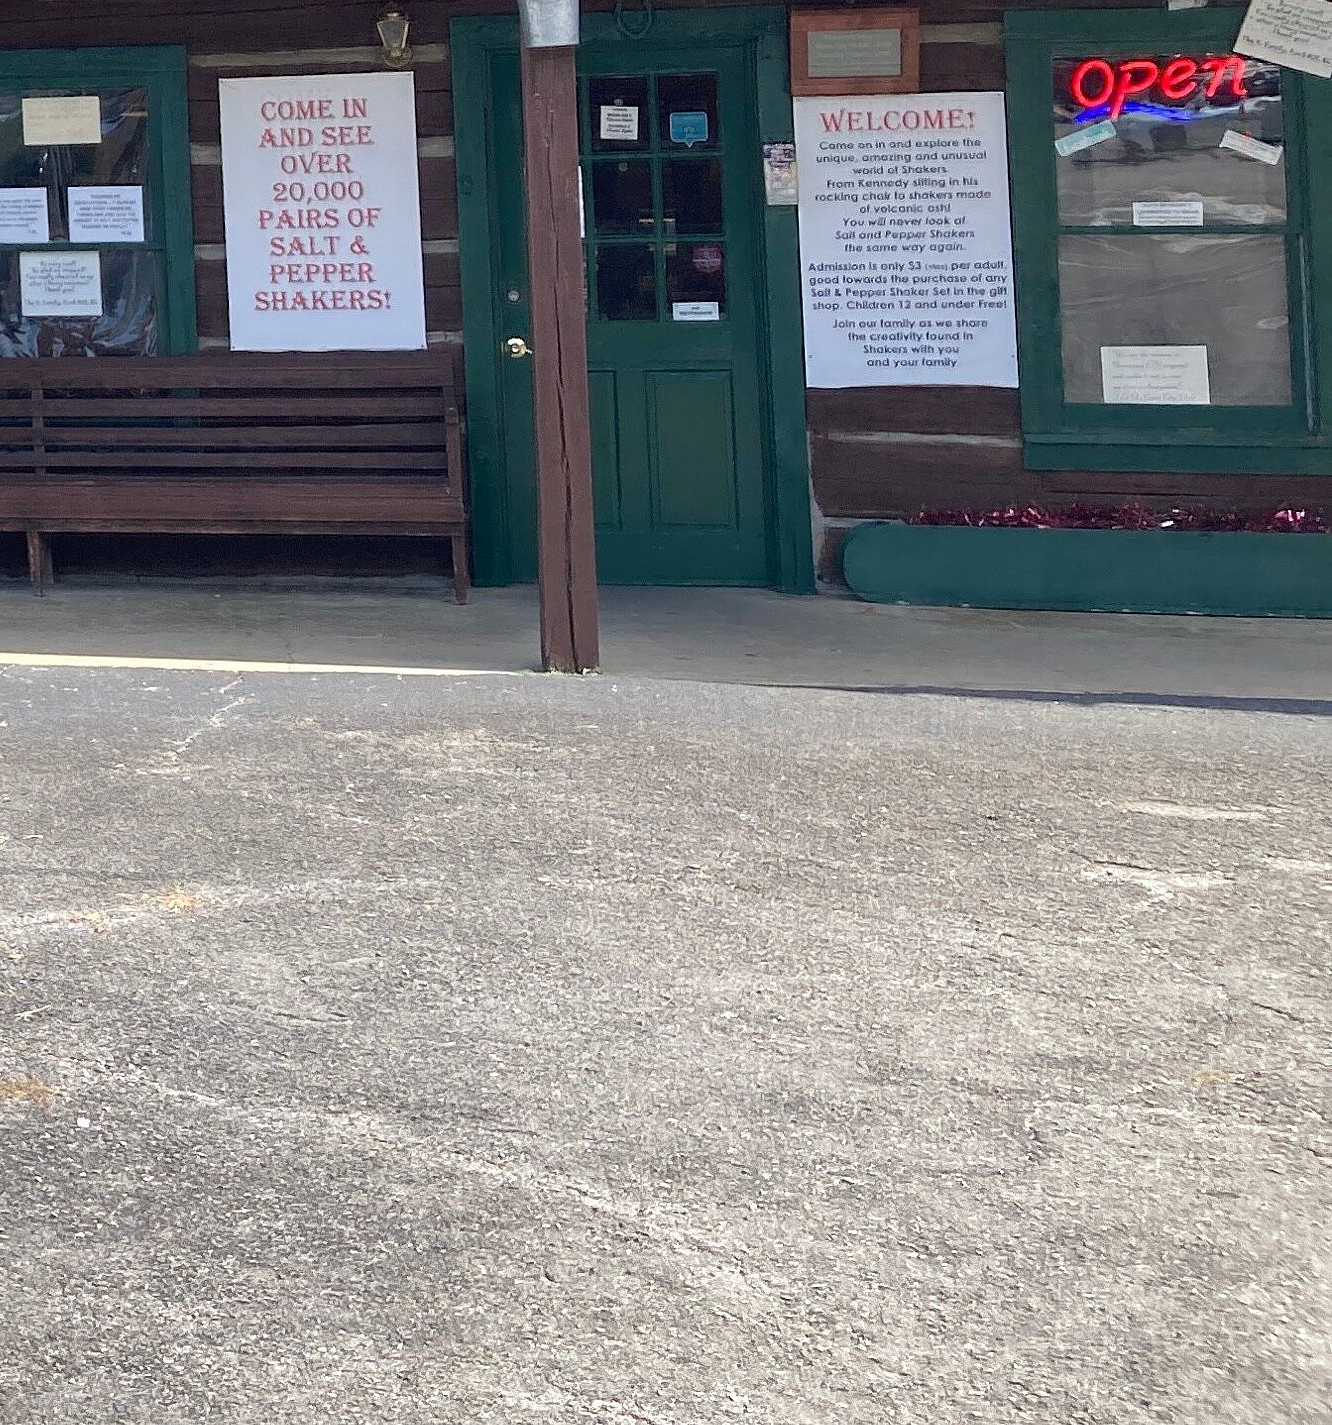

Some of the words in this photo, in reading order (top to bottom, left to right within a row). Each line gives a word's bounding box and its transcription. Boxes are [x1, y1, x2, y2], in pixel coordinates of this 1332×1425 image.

[260, 98, 336, 122] COME
[342, 97, 367, 119] IN
[819, 107, 976, 133] WELCOME!
[258, 127, 314, 148] AND
[321, 125, 376, 147] SEE
[819, 141, 855, 151] Come
[857, 141, 873, 150] on
[875, 138, 886, 149] in
[889, 139, 912, 149] and
[915, 138, 959, 150] explore
[962, 137, 982, 148] the
[280, 151, 354, 175] OVER
[861, 153, 912, 164] amazing
[915, 151, 938, 161] and
[941, 149, 987, 161] unusual
[852, 165, 884, 175] world
[887, 164, 899, 175] of
[826, 179, 855, 189] From
[858, 177, 909, 189] Kennedy
[912, 176, 947, 188] sitting
[948, 176, 960, 187] in
[962, 176, 979, 187] his
[272, 180, 364, 206] 20,000
[815, 191, 859, 203] rocking
[861, 190, 891, 201] chair
[893, 190, 906, 201] to
[908, 190, 953, 201] shakers
[955, 189, 992, 200] made
[859, 204, 870, 214] of
[873, 204, 924, 214] volcanic
[927, 202, 952, 213] ash!
[258, 207, 340, 230] PAIRS
[347, 207, 382, 229] OF
[842, 217, 865, 227] You
[867, 216, 887, 227] will
[889, 218, 923, 227] never
[925, 216, 951, 226] look
[953, 215, 967, 226] at
[834, 230, 856, 241] Salt
[858, 230, 882, 240] and
[885, 230, 927, 241] Pepper
[929, 228, 976, 239] Shakers
[269, 235, 341, 257] SALT
[349, 234, 370, 255] &
[844, 243, 863, 253] the
[866, 244, 898, 253] same
[901, 244, 926, 254] way
[269, 262, 377, 285] PEPPER
[808, 262, 866, 272] Admission
[868, 261, 878, 271] is
[880, 261, 905, 272] only
[950, 261, 971, 272] per
[808, 275, 839, 287] good
[842, 274, 888, 285] towards
[890, 274, 910, 284] the
[912, 273, 967, 285] purchase
[970, 273, 984, 283] of
[985, 274, 1008, 284] any
[810, 287, 832, 298] Salt
[834, 287, 842, 297] &
[845, 287, 887, 299] Pepper
[889, 286, 930, 297] Shaker
[932, 285, 952, 296] Set
[953, 285, 964, 296] in
[966, 285, 986, 296] the
[988, 285, 1008, 298] gift
[254, 288, 392, 312] SHAKERS!
[812, 301, 843, 312] shop.
[846, 299, 895, 310] Children
[914, 299, 938, 309] and
[941, 299, 976, 309] under
[978, 298, 1008, 309] Free!
[832, 318, 856, 329] Join
[858, 319, 877, 328] our
[879, 317, 916, 329] family
[919, 319, 933, 328] as
[935, 319, 953, 328] we
[955, 318, 988, 328] share
[847, 331, 866, 341] the
[869, 331, 923, 342] creativity
[925, 330, 960, 341] found
[962, 330, 974, 341] in
[863, 343, 909, 354] Shakers
[911, 344, 935, 354] with
[937, 346, 960, 356] you
[866, 357, 890, 367] and
[893, 358, 919, 368] your
